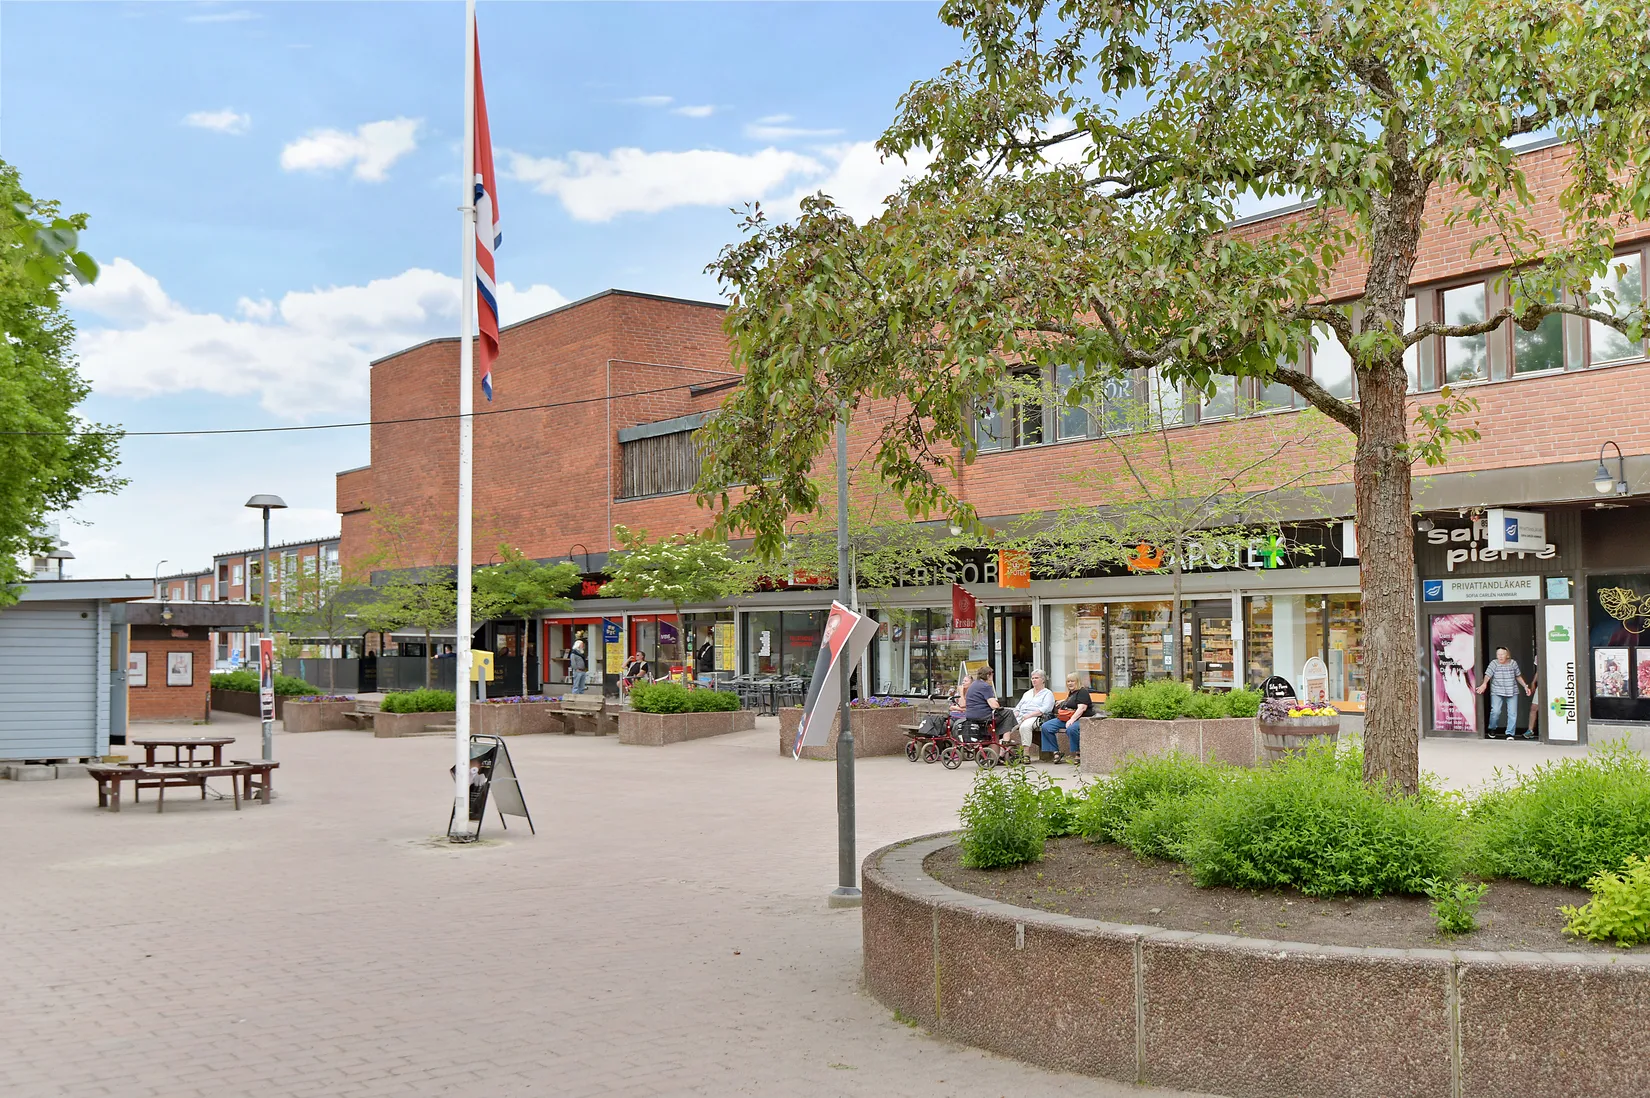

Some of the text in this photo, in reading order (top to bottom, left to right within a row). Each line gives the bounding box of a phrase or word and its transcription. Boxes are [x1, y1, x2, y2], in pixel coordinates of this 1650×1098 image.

[900, 558, 998, 588] FRISÖR
[1451, 580, 1532, 591] PRIVATTANDLÄKARE
[955, 618, 975, 628] Frisör
[1560, 661, 1576, 725] Tellusbarn
